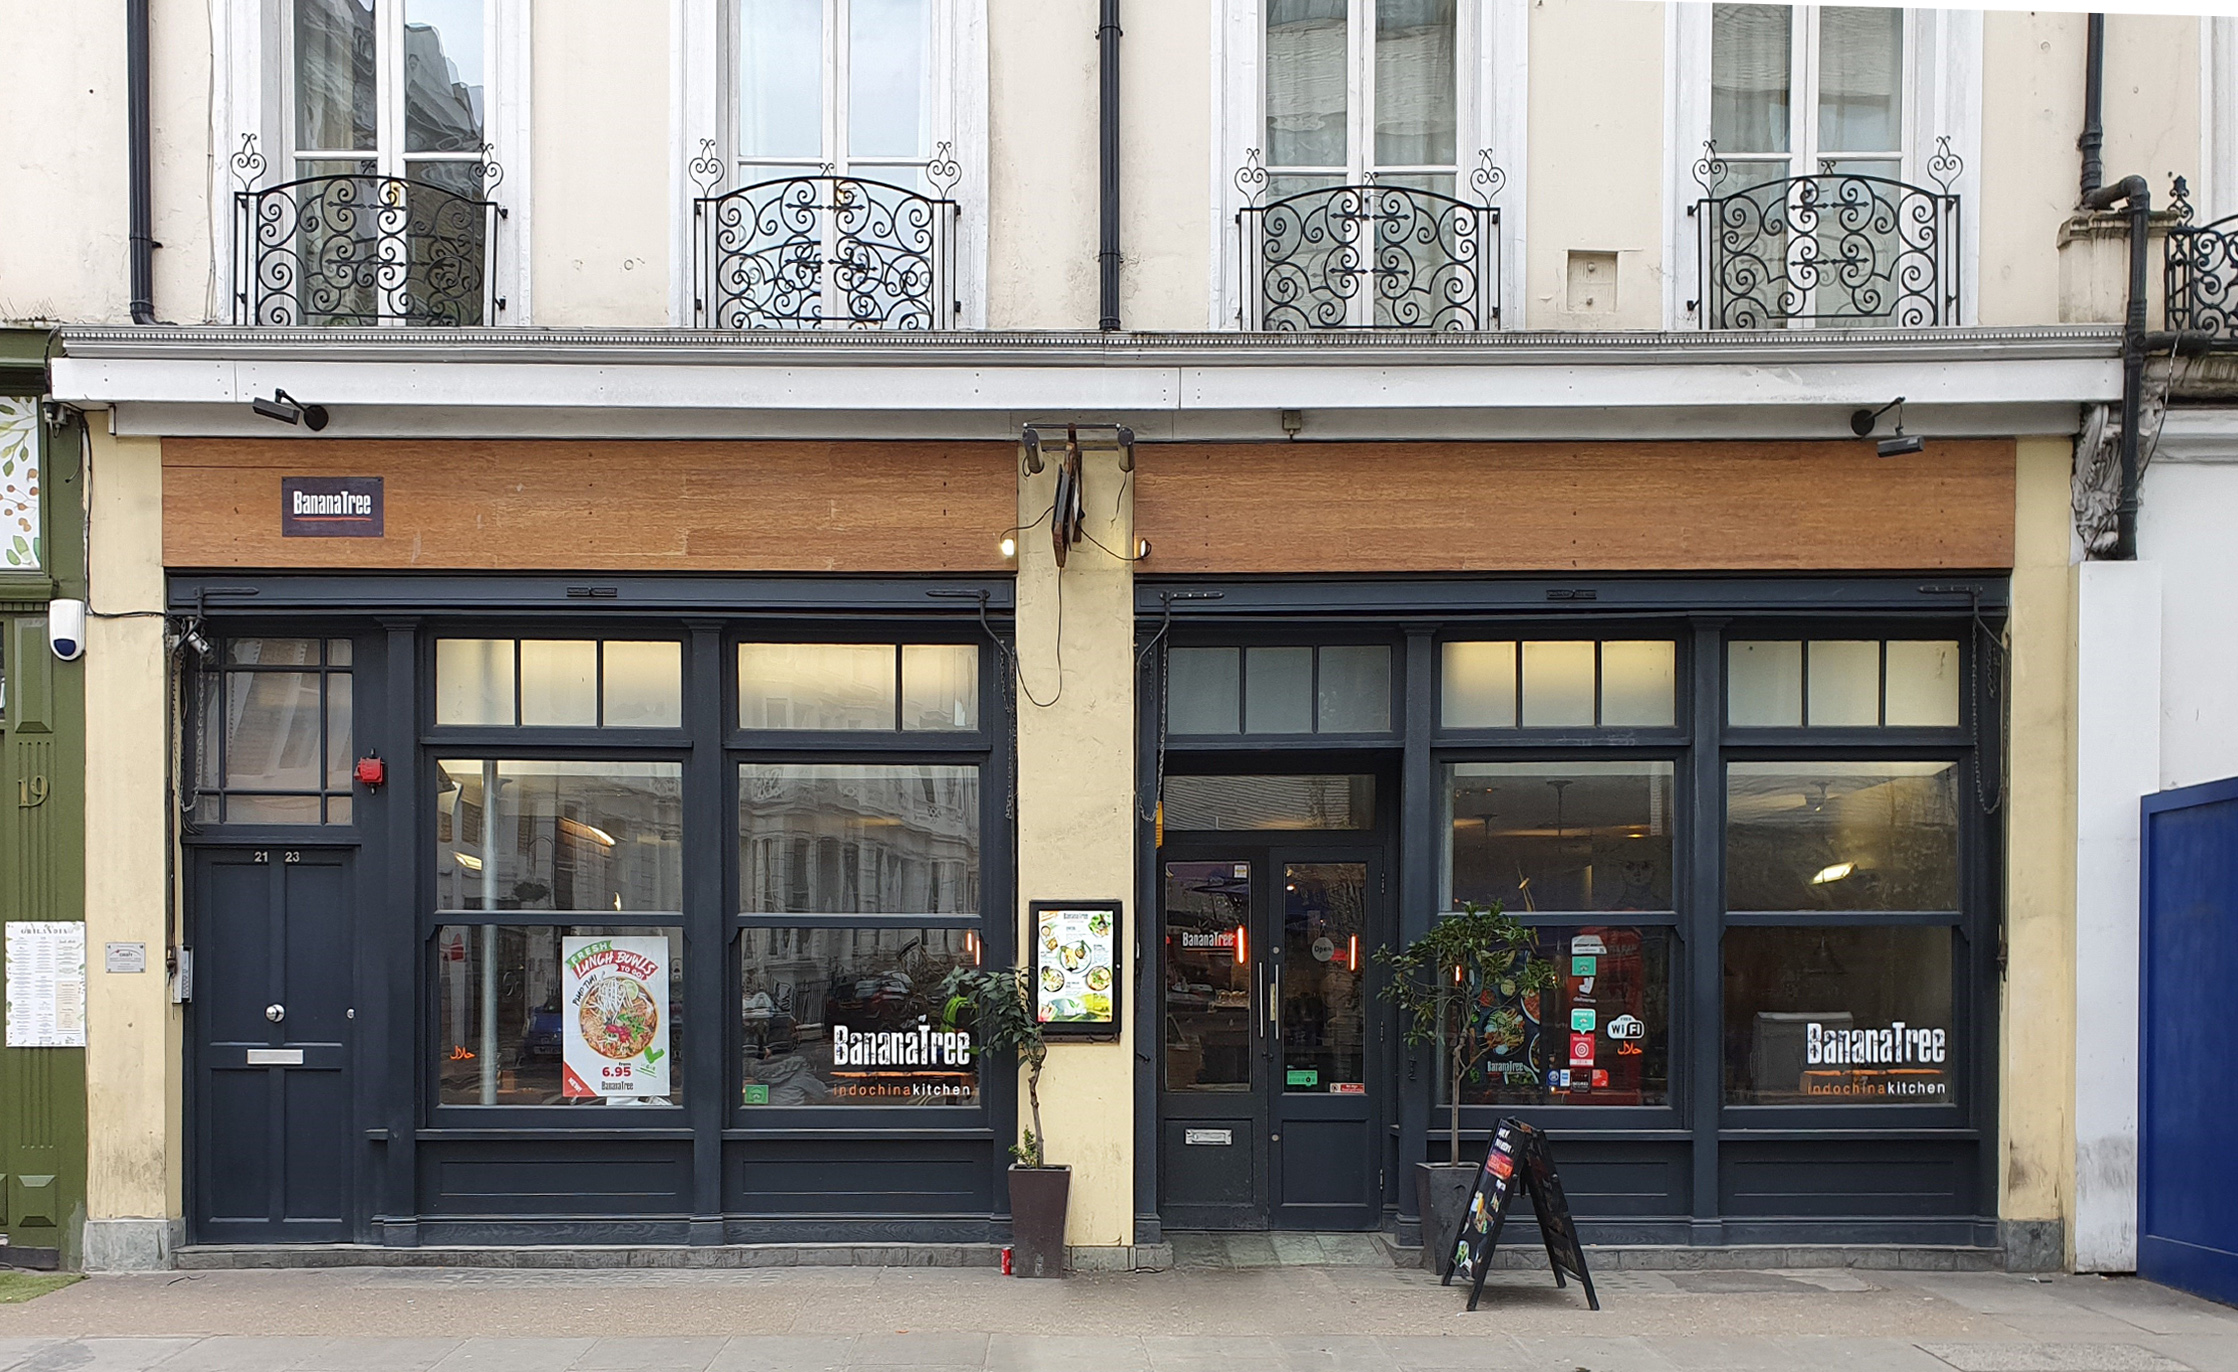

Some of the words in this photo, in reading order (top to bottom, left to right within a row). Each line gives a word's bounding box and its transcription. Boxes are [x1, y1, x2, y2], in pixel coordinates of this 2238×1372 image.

[293, 490, 372, 515] BananaTree
[18, 775, 50, 808] 19
[254, 851, 269, 863] 21
[285, 851, 300, 863] 23
[1182, 931, 1234, 947] BananaTree
[570, 941, 608, 965] FRESH
[575, 951, 614, 977] LUNCH
[616, 951, 656, 975] BOWLS
[620, 965, 630, 974] TO
[450, 1044, 476, 1060] حلال
[833, 1024, 971, 1066] BananaTree
[1807, 1022, 1946, 1064] BananaTree
[602, 1066, 632, 1077] 6.95
[601, 1080, 634, 1091] BananaTree
